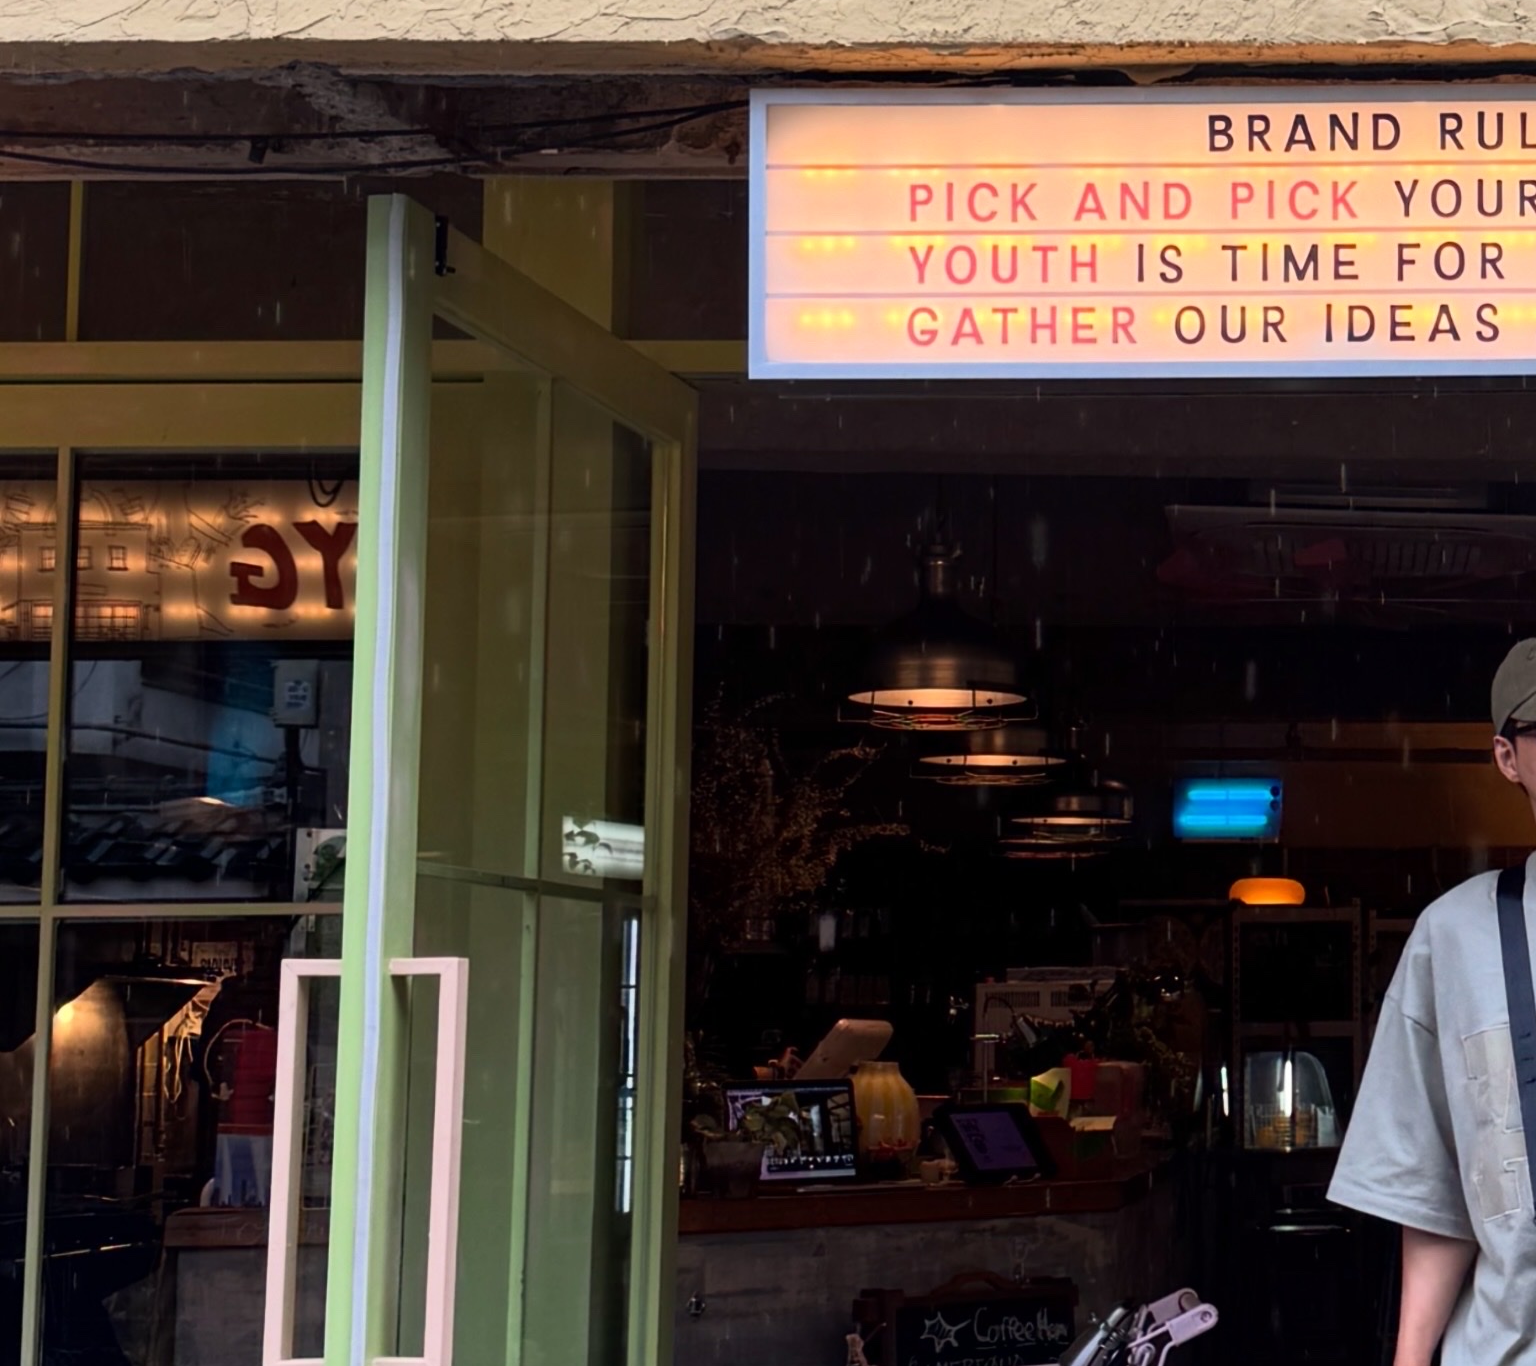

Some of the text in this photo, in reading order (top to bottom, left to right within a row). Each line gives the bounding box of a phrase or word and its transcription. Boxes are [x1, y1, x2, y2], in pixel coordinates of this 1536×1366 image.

[1208, 112, 1401, 152] BRAND
[910, 183, 1036, 221] PICK
[1075, 182, 1191, 220] AND
[1231, 180, 1356, 219] PICK
[910, 245, 1096, 284] YOUTH
[1137, 243, 1183, 284] IS
[1221, 243, 1359, 283] TIME
[1397, 241, 1505, 282] FOR
[908, 306, 1136, 346] GATHER
[1174, 304, 1287, 345] OUR
[1325, 303, 1500, 343] IDEAS
